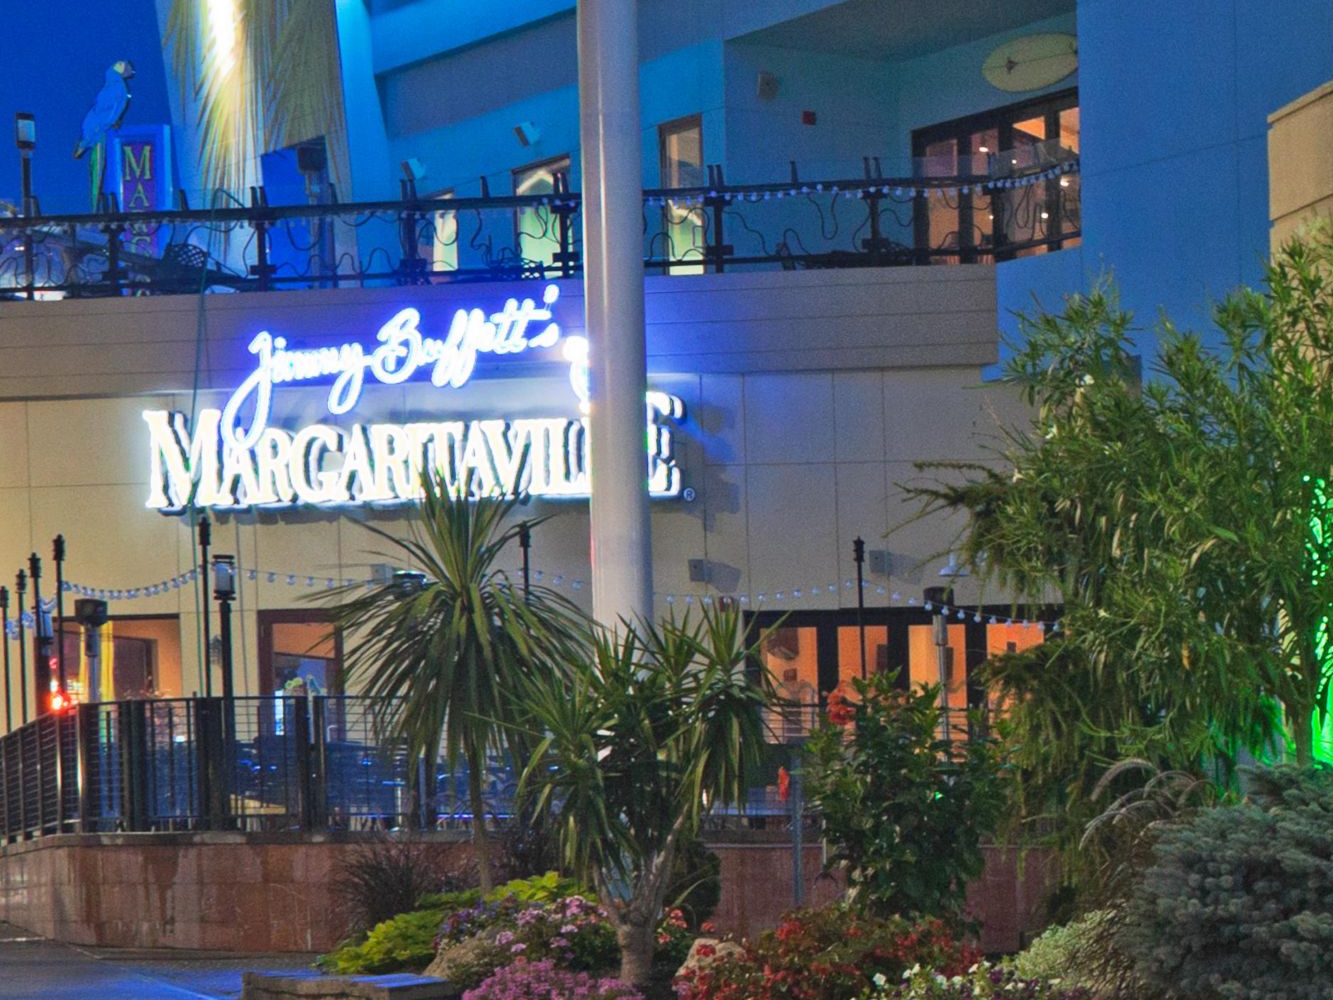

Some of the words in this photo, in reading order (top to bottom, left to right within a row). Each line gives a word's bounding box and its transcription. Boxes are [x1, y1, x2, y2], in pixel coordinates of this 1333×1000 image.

[220, 330, 366, 449] Jimmy
[370, 284, 560, 388] Buffett's
[141, 391, 688, 512] MARGARITAVILE
